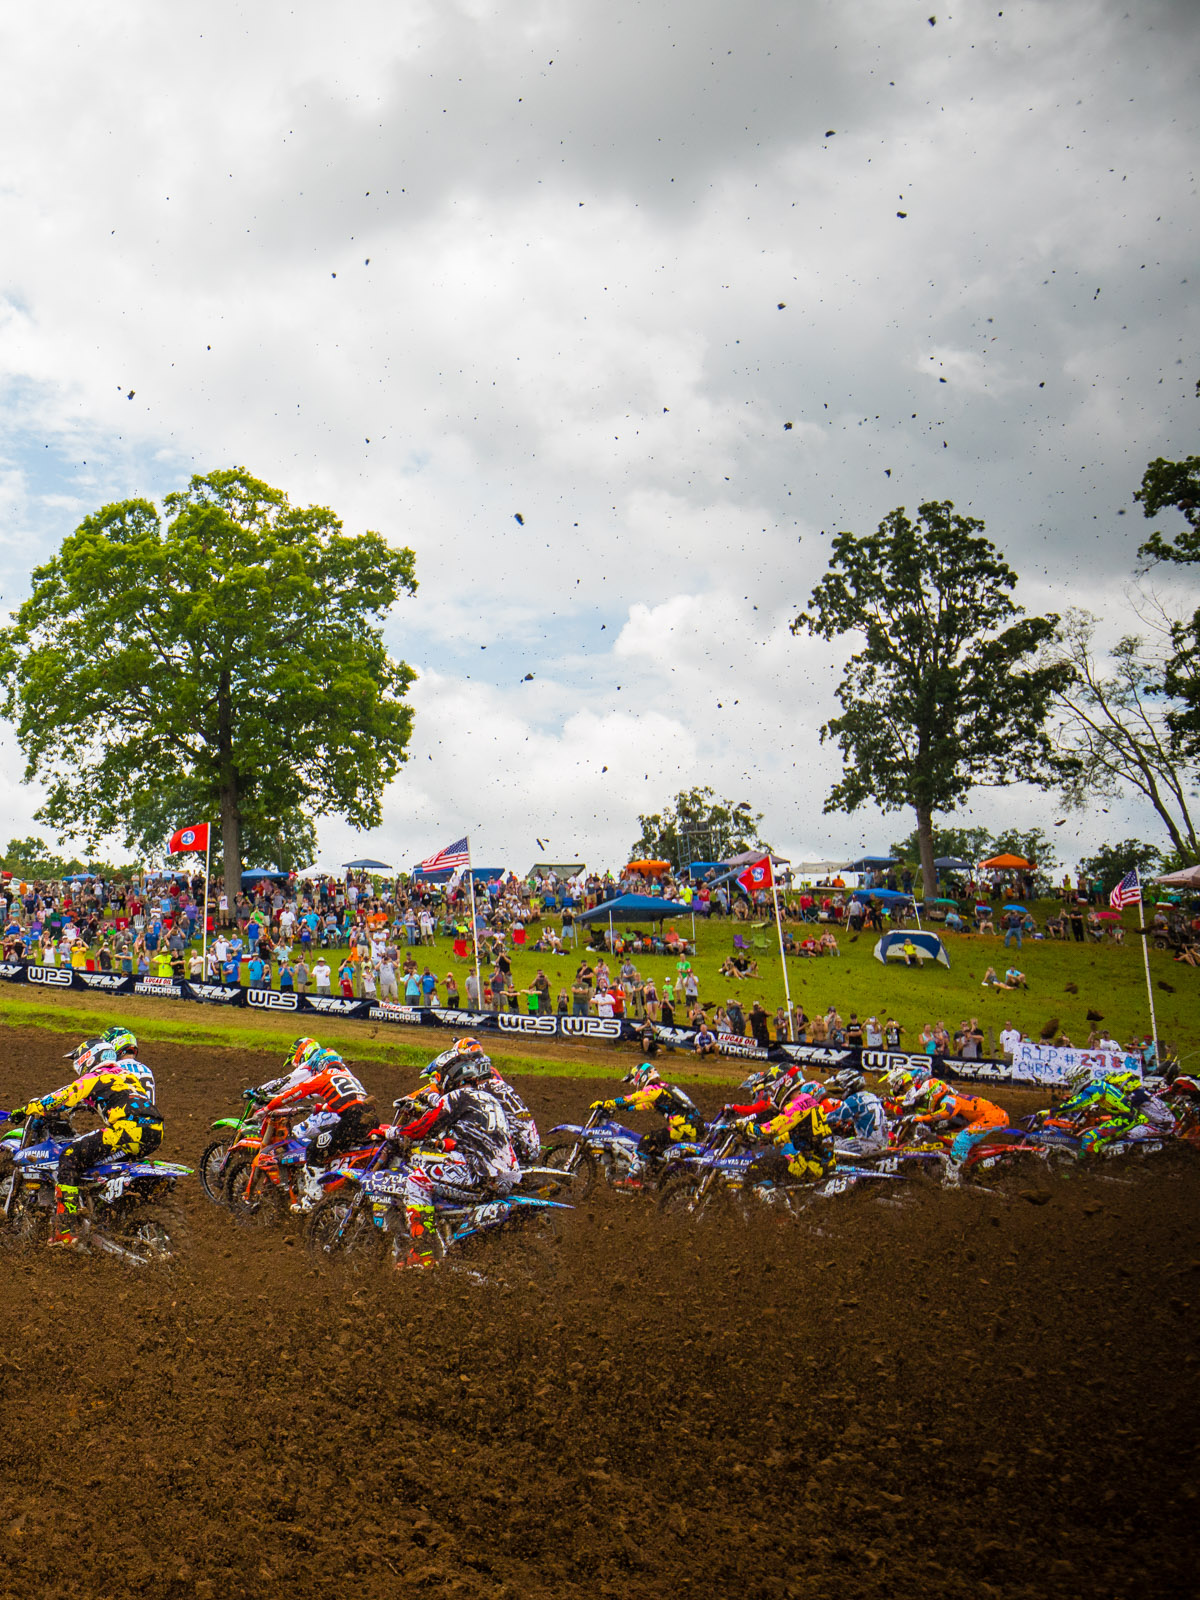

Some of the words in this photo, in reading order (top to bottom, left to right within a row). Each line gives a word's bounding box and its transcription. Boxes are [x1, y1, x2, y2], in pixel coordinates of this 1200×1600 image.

[27, 966, 73, 986] WPS
[134, 985, 181, 995] MOTOCROSS
[247, 989, 299, 1010] WPS
[369, 1009, 422, 1021] MOTOCROSS
[498, 1014, 557, 1035] WPS
[560, 1016, 622, 1038] WPS
[719, 1034, 743, 1044] LUCAS
[744, 1038, 757, 1046] OIL
[780, 1044, 852, 1061] FLY
[861, 1049, 933, 1073] WPS
[1021, 1047, 1058, 1062] RIP
[372, 1170, 408, 1184] Cycle
[106, 1176, 125, 1200] 39
